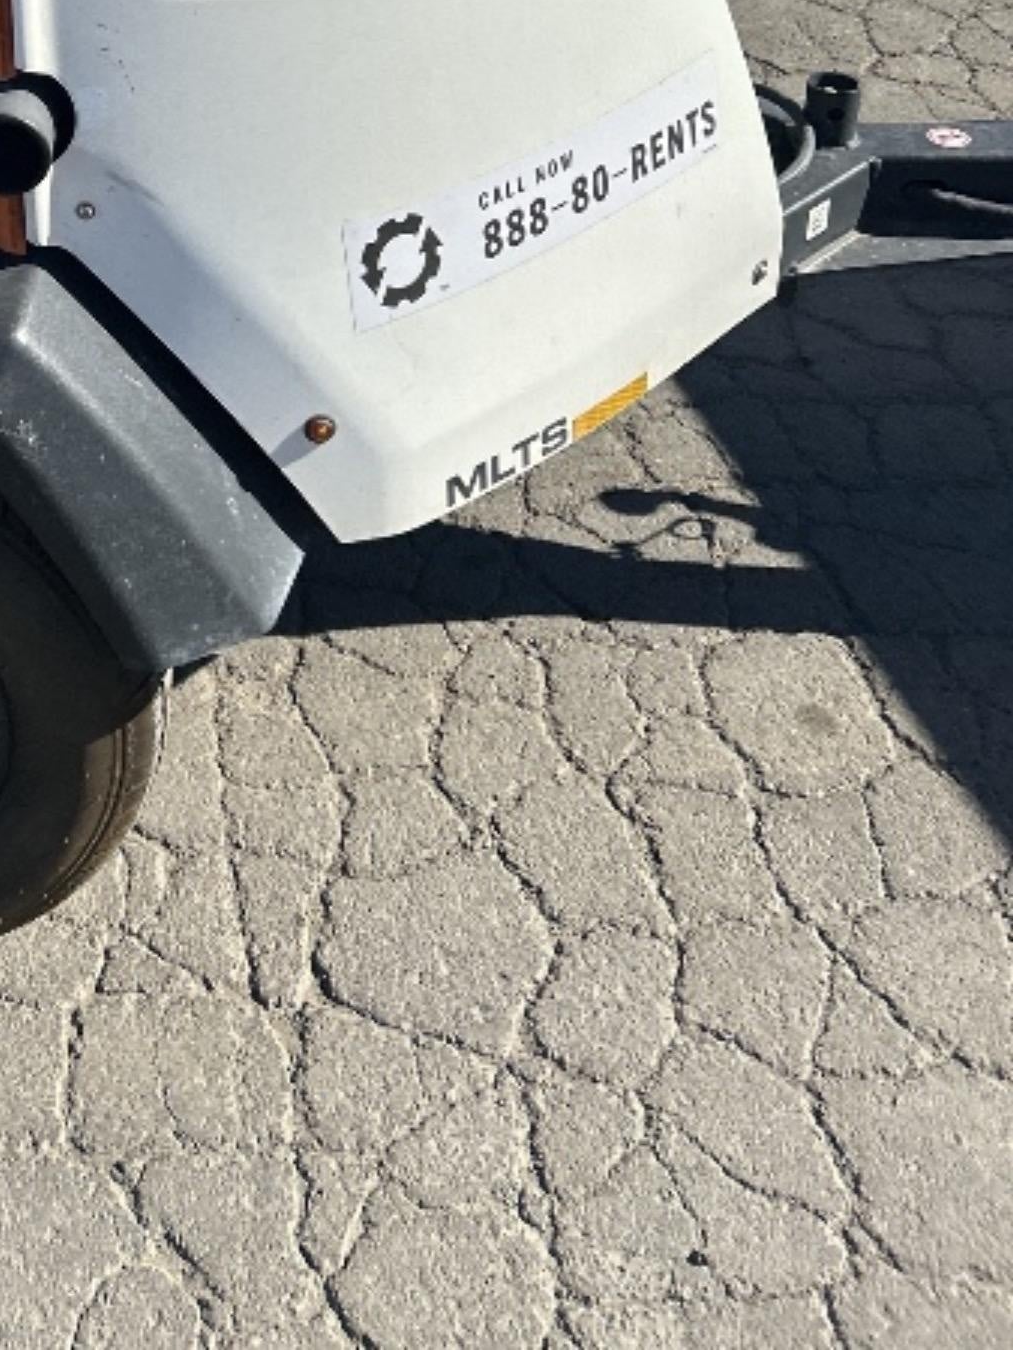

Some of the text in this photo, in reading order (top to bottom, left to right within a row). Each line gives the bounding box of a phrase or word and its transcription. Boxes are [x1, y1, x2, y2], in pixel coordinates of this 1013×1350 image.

[478, 149, 575, 210] CALL NOW
[482, 99, 718, 259] 888-80-RENTS
[444, 417, 569, 509] MLTS
